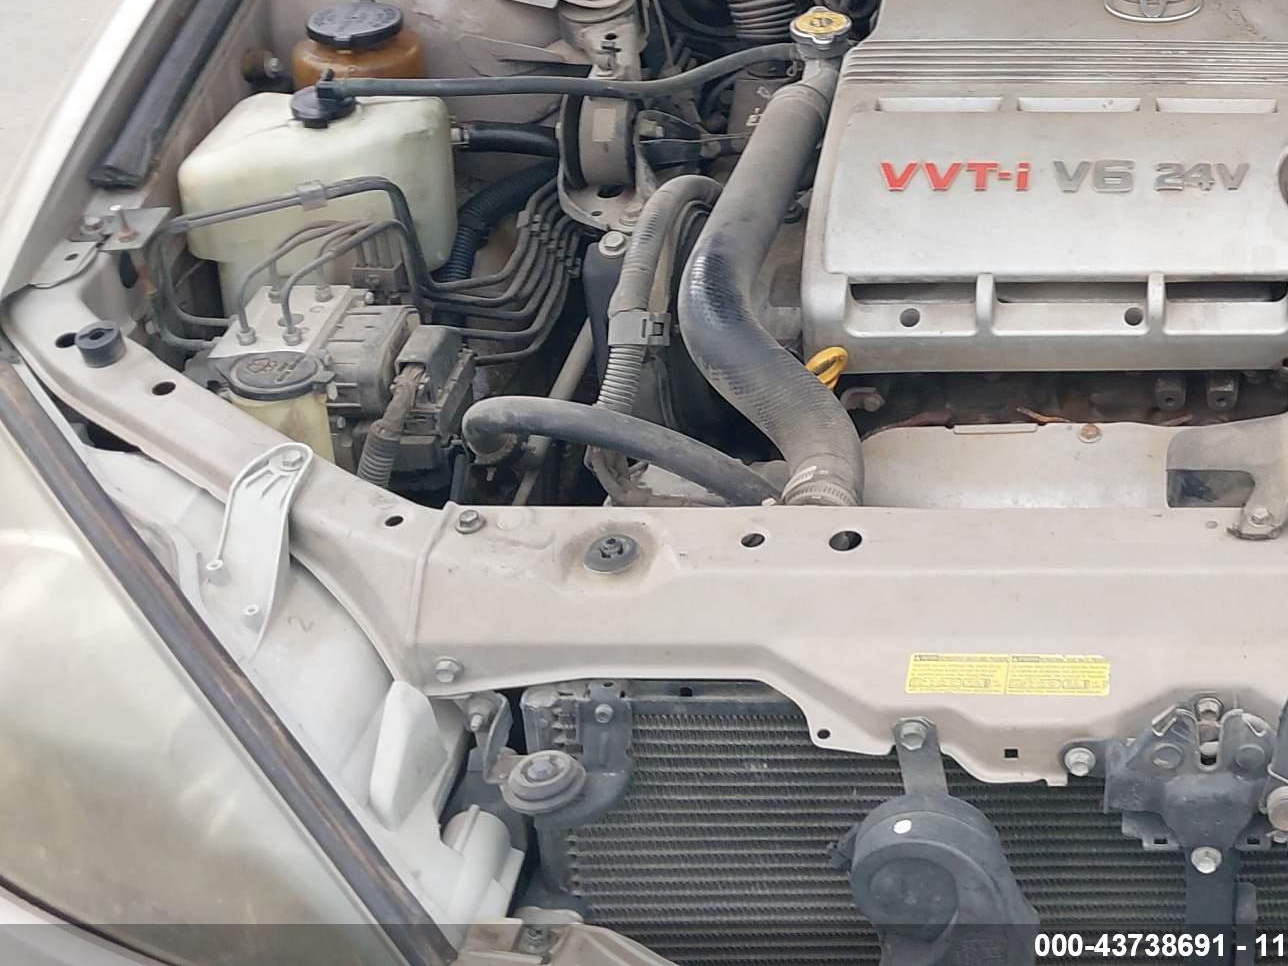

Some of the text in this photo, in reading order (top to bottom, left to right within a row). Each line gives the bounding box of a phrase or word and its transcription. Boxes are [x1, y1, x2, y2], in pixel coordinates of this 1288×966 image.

[881, 160, 1251, 194] VVT-i V6 24V
